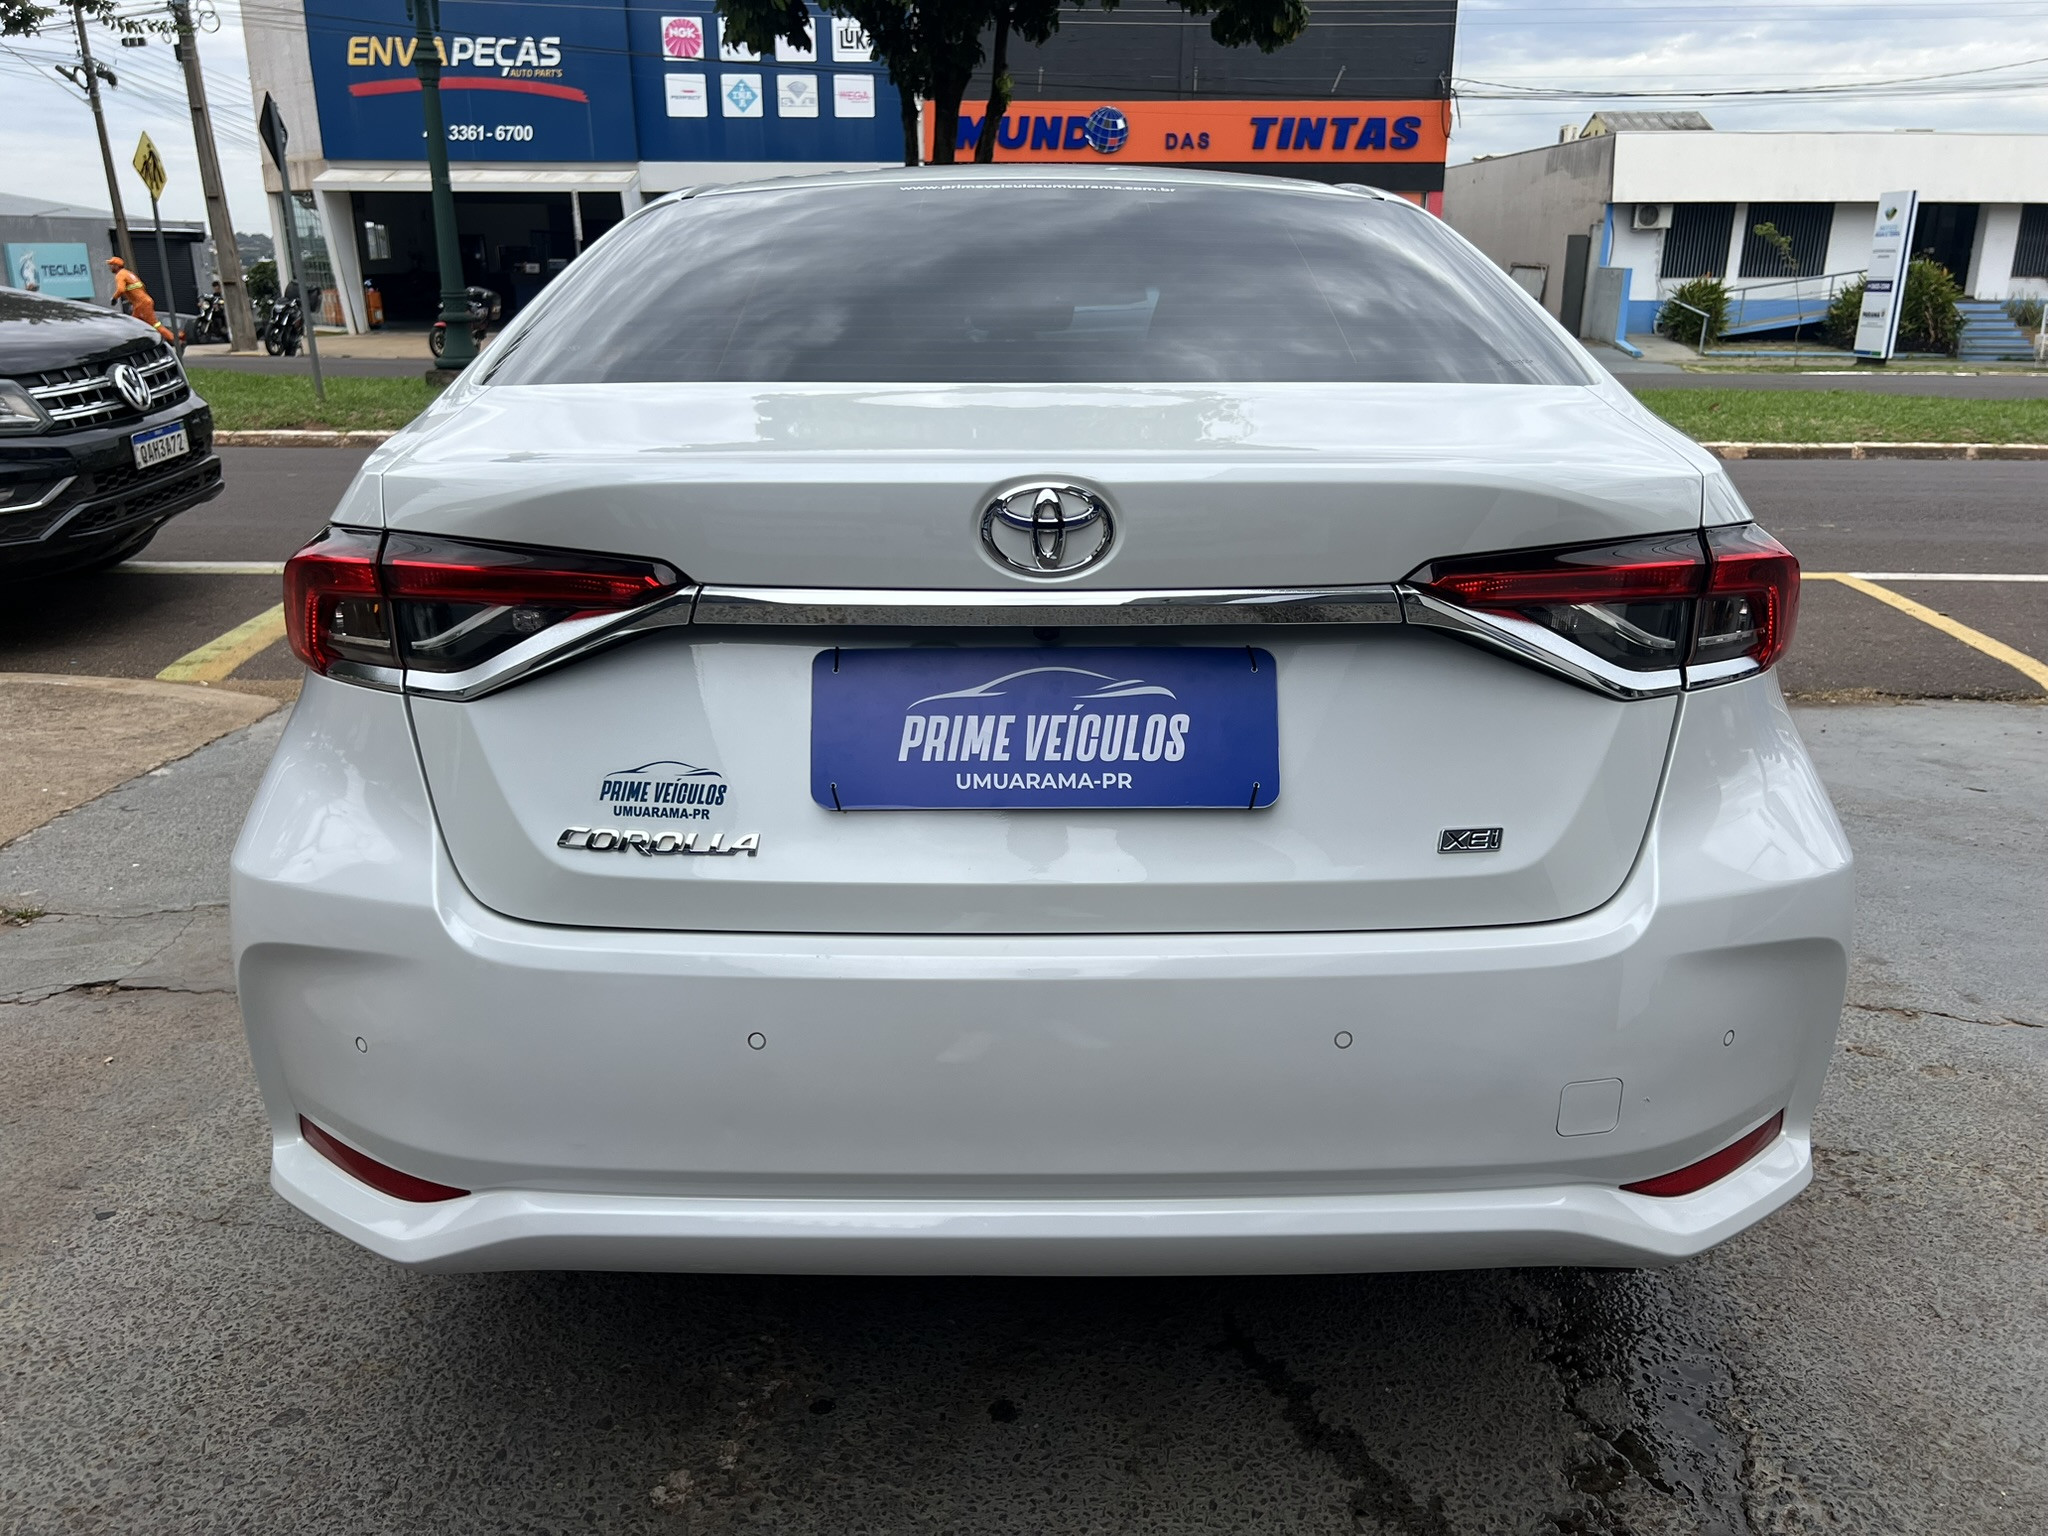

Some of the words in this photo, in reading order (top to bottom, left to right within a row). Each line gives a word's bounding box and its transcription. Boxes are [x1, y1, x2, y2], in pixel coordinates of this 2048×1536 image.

[669, 27, 696, 39] NGK
[511, 68, 533, 78] AUTO
[1165, 133, 1210, 150] DAS
[1250, 116, 1422, 151] TINTAS
[41, 264, 88, 276] TECILAR
[140, 433, 185, 464] QAH3A72
[898, 714, 1016, 762] PRIME
[1025, 704, 1190, 762] VEÍCULOS
[599, 780, 651, 803] PRIME
[653, 778, 727, 806] VEÍCULOS
[955, 773, 1133, 790] UMUARAMA-PR
[613, 805, 710, 820] UMUARAMA-PR
[557, 826, 761, 857] COROLLA
